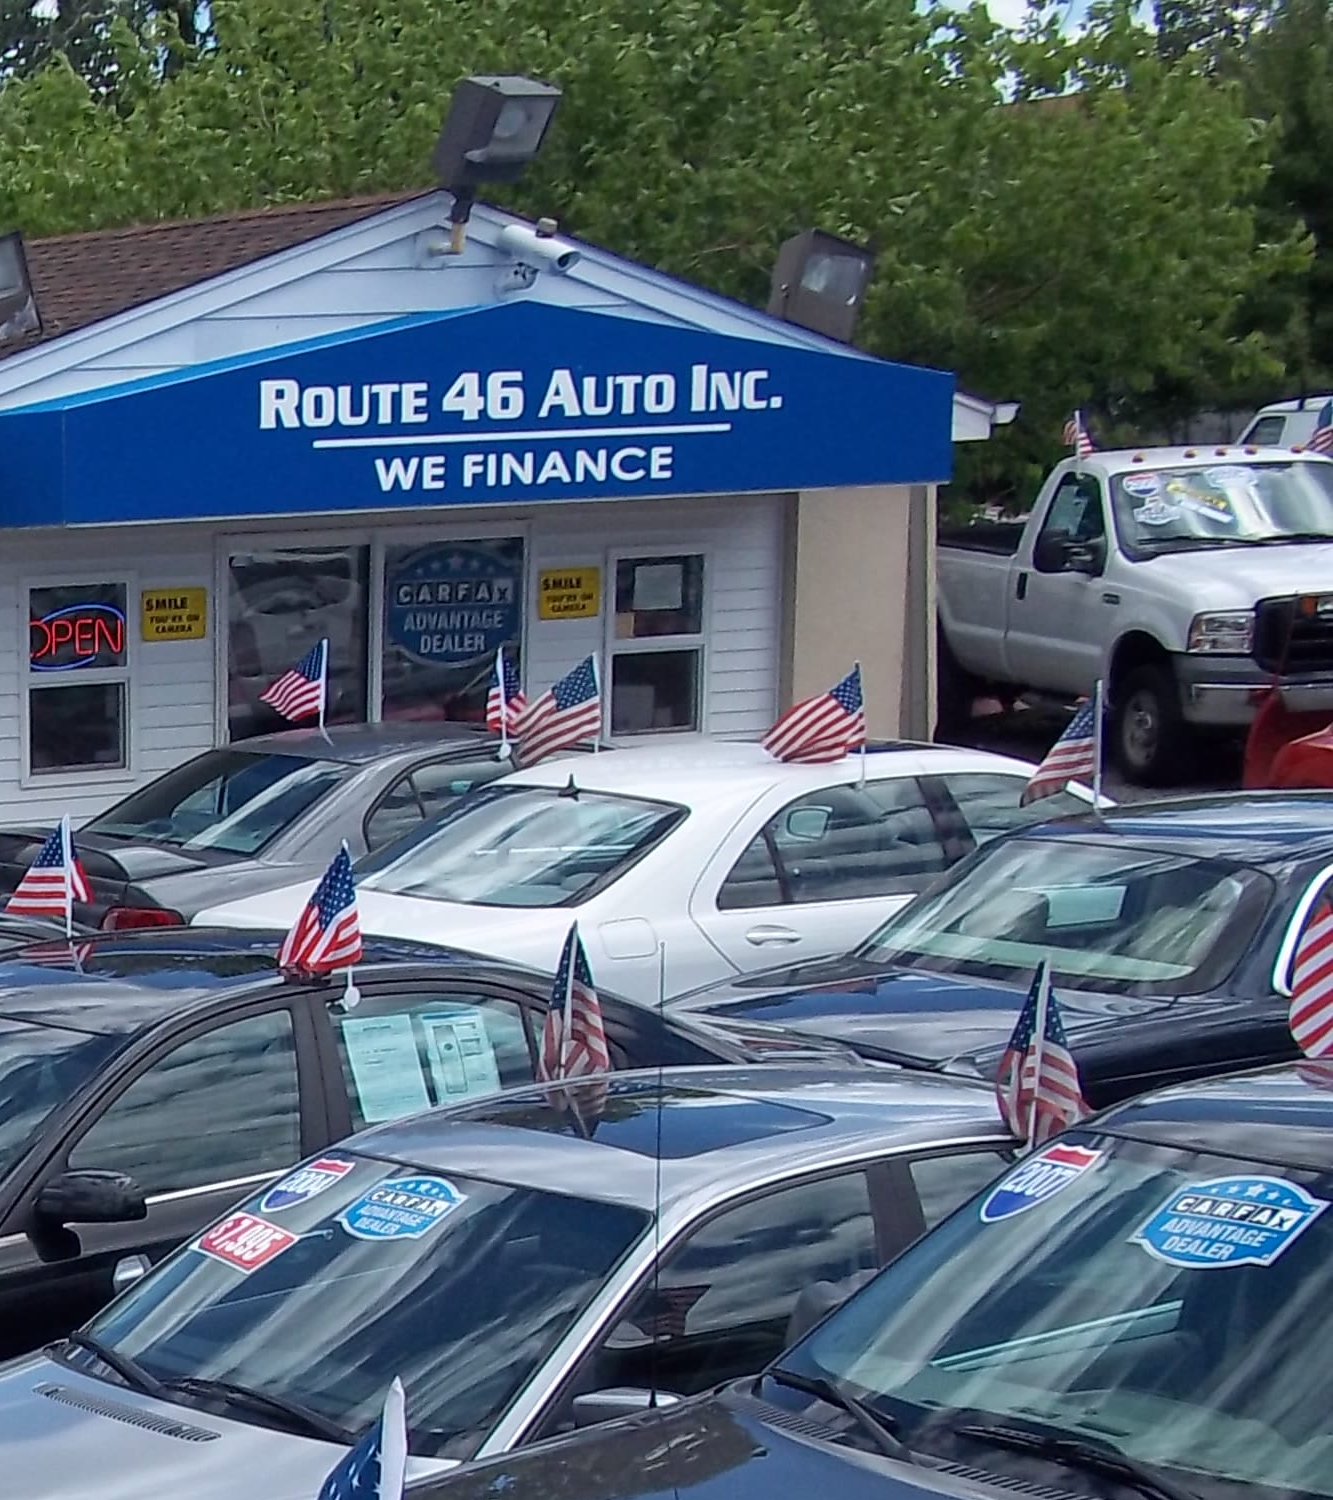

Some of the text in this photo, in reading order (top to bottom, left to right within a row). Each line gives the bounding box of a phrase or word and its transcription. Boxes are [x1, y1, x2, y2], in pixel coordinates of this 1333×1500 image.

[259, 378, 429, 429] ROUTE
[442, 370, 524, 421] 46
[538, 368, 676, 418] AUTO
[374, 446, 674, 492] WE FINANCE
[145, 597, 188, 611] SMILE
[396, 581, 513, 605] CARFAX
[403, 611, 504, 632] ADVANTAGE
[29, 618, 123, 659] OPEN
[420, 634, 485, 655] DEALER
[1000, 1163, 1079, 1198] 2007
[371, 1190, 444, 1217] CARFAX
[1175, 1198, 1297, 1231] CARFAX
[1160, 1217, 1269, 1247] ADVANTAGE
[1161, 1236, 1236, 1260] DEALER
